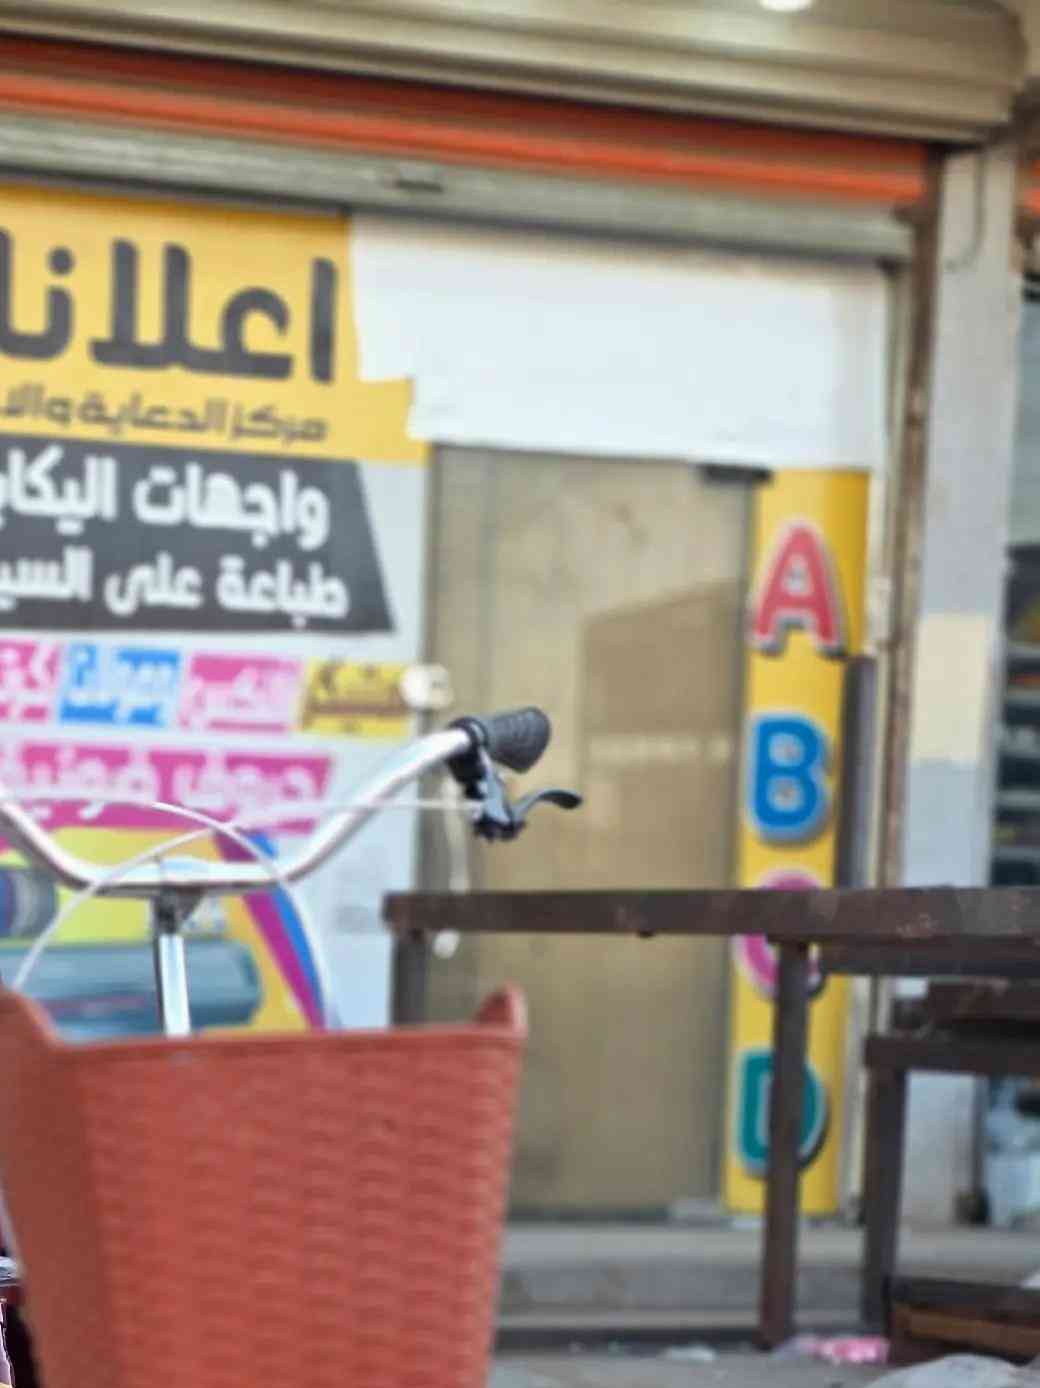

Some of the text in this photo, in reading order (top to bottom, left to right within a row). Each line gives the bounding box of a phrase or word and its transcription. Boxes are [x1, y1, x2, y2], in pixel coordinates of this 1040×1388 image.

[76, 391, 226, 436] الدعاية
[231, 399, 329, 446] مركز
[132, 462, 330, 551] واجهات
[104, 551, 205, 616] على
[216, 554, 350, 627] طباعة
[751, 517, 847, 659] A
[744, 709, 834, 847] B
